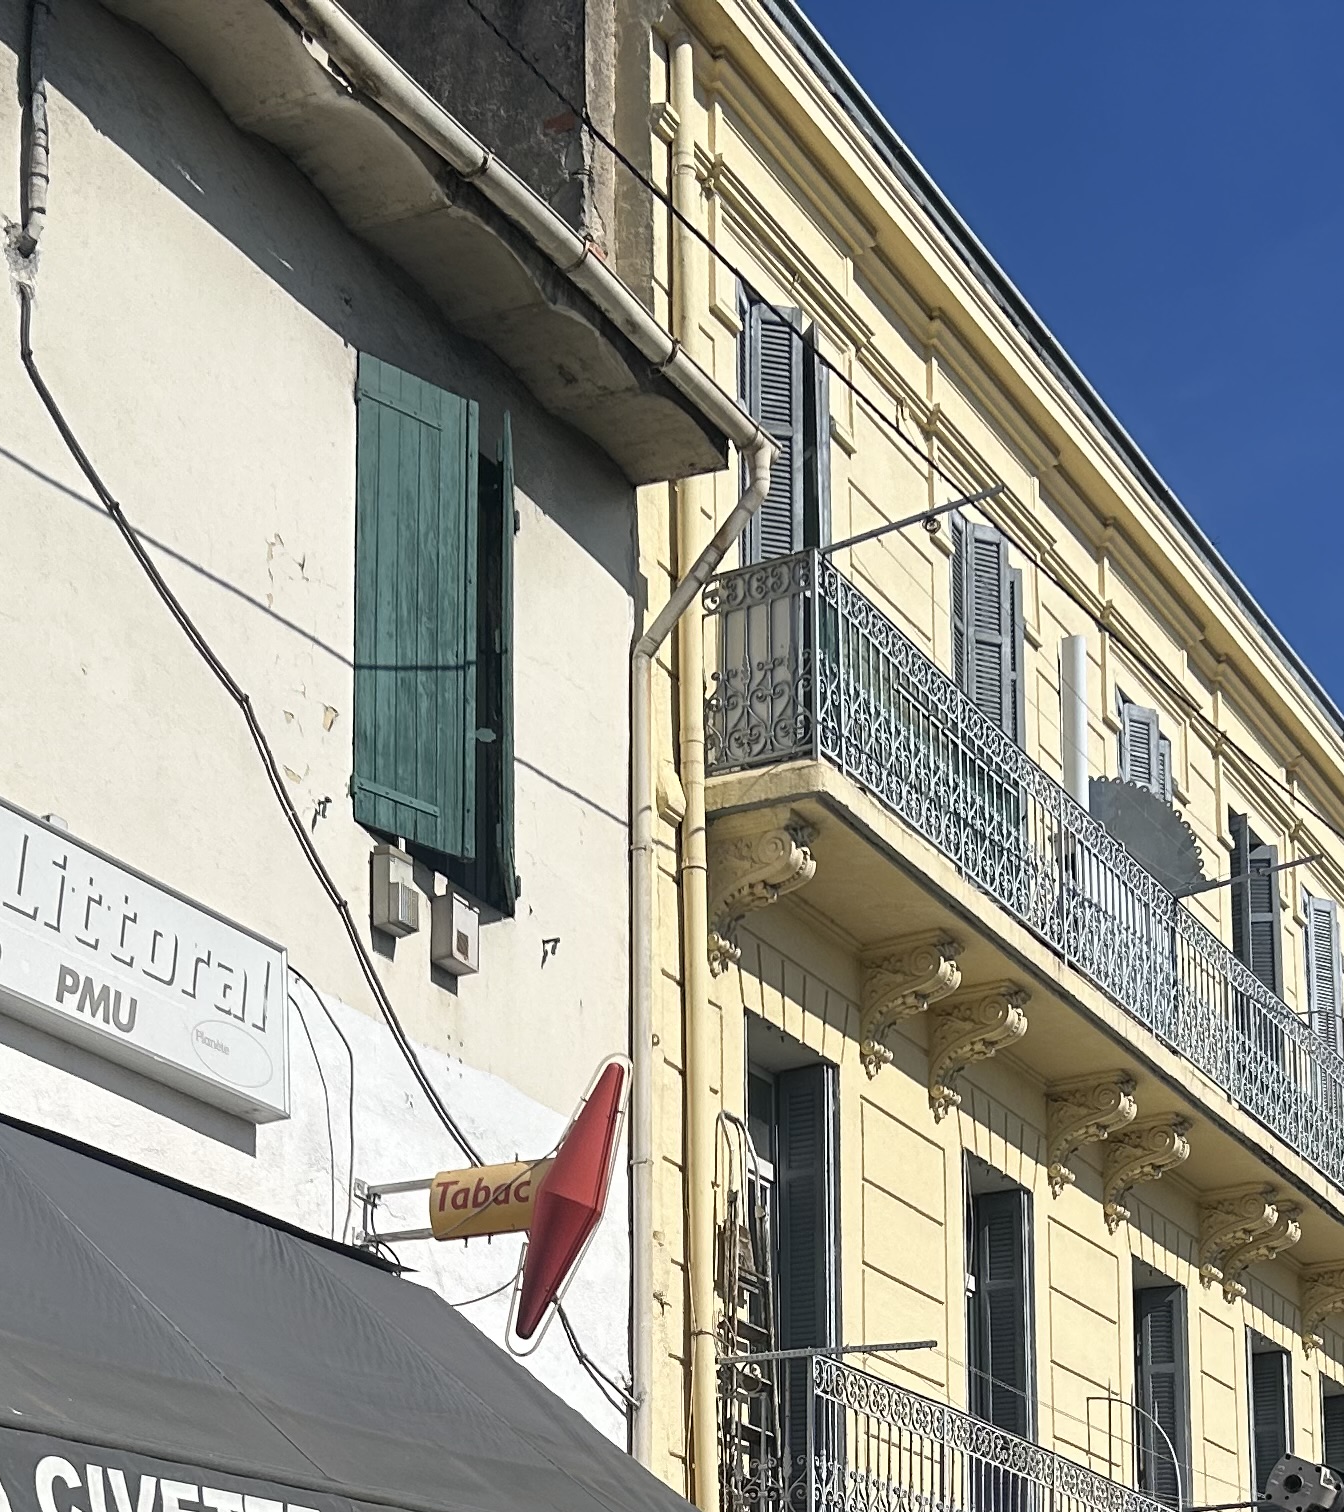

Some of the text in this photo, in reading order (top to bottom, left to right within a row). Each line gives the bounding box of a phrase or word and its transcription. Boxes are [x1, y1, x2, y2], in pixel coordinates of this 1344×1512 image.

[3, 834, 269, 1034] Littoral
[57, 965, 138, 1034] PMU
[435, 1175, 532, 1215] Tabac
